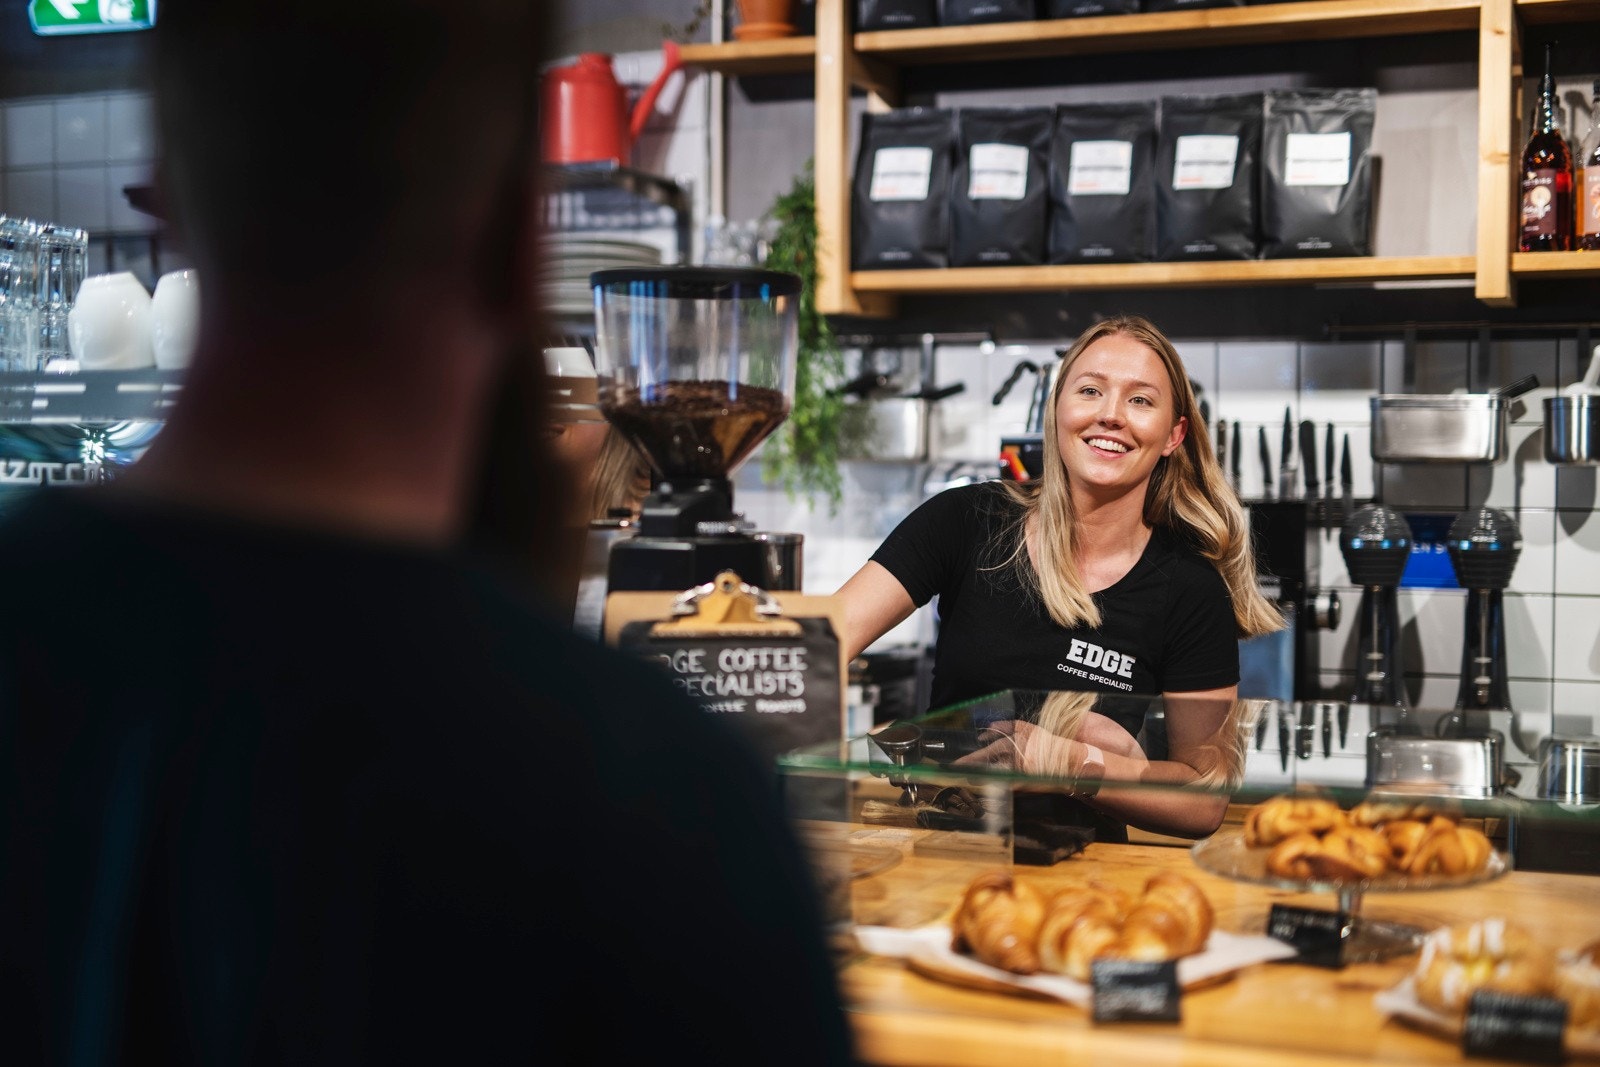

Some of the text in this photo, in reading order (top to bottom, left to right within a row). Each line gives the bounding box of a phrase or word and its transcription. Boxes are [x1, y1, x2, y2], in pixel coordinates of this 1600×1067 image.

[659, 647, 808, 673] GE COFFEE
[1066, 638, 1136, 678] EDGE
[673, 670, 805, 697] PECIALISTS
[1057, 663, 1133, 692] COFFEE SPECIALISTS
